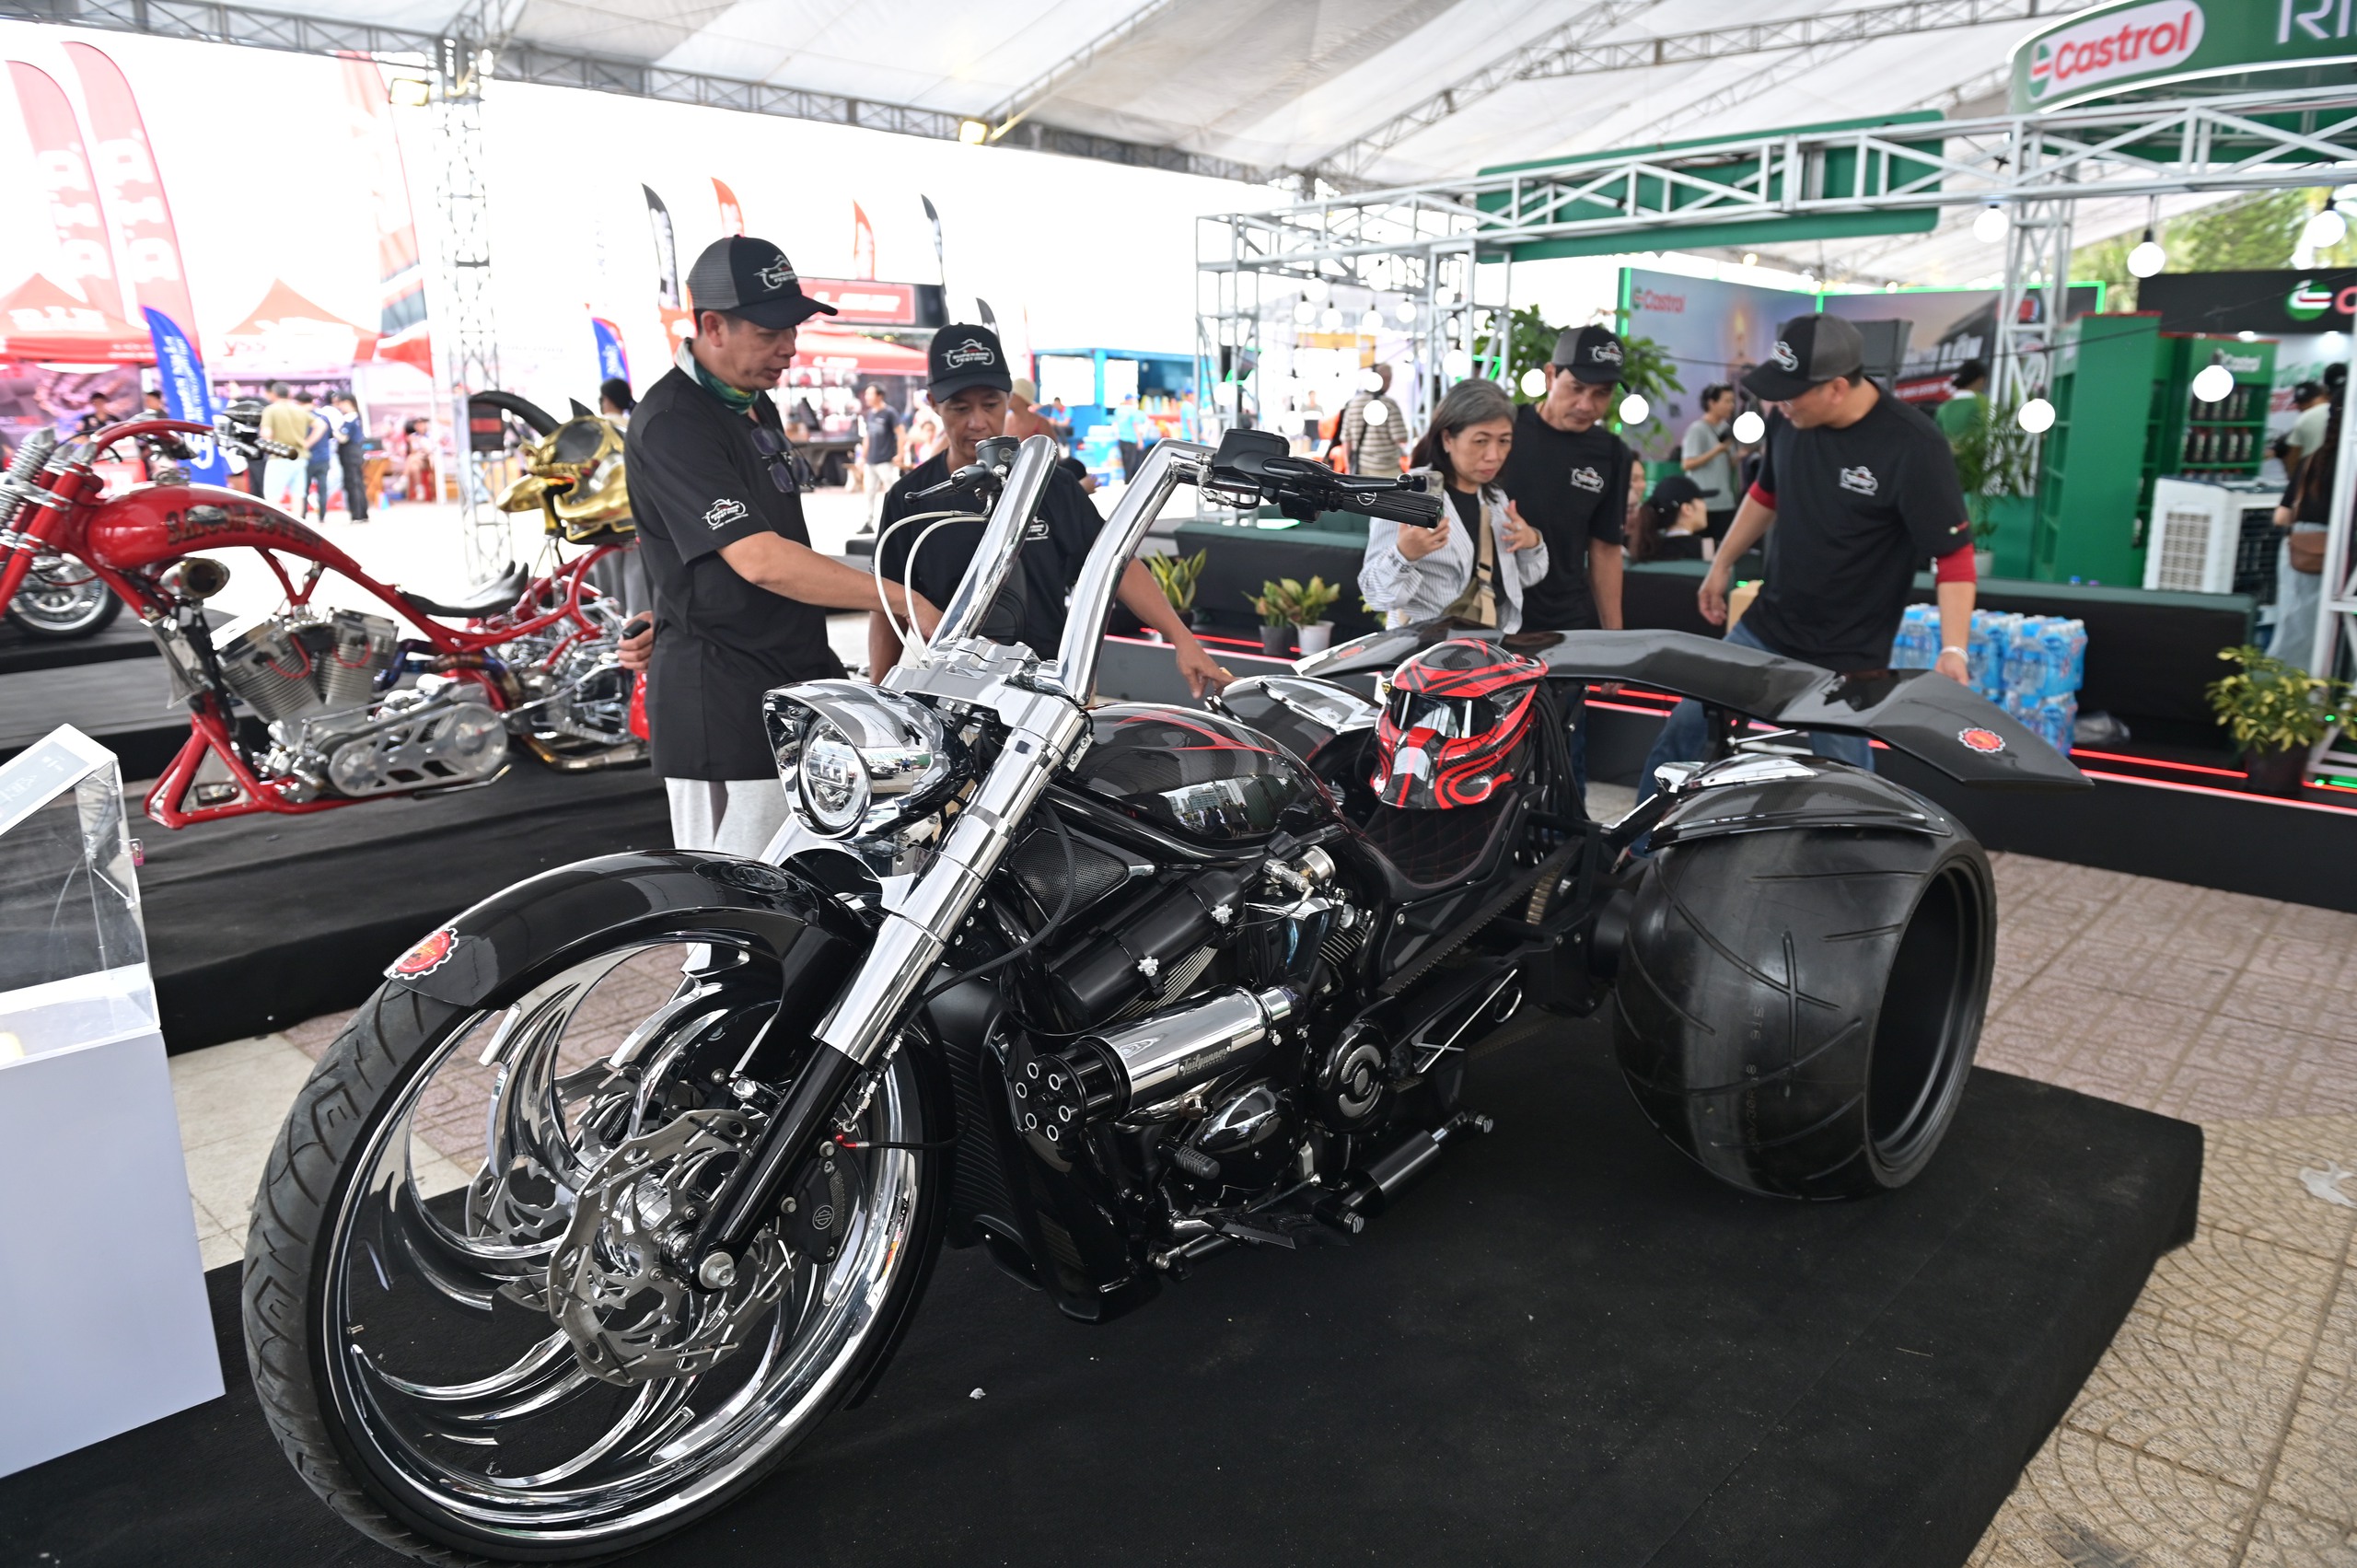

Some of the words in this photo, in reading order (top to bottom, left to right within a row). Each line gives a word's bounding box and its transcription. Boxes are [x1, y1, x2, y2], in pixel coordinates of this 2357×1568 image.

[2276, 0, 2357, 44] RI
[2055, 9, 2193, 80] Castrol
[1644, 289, 1686, 313] Castrol
